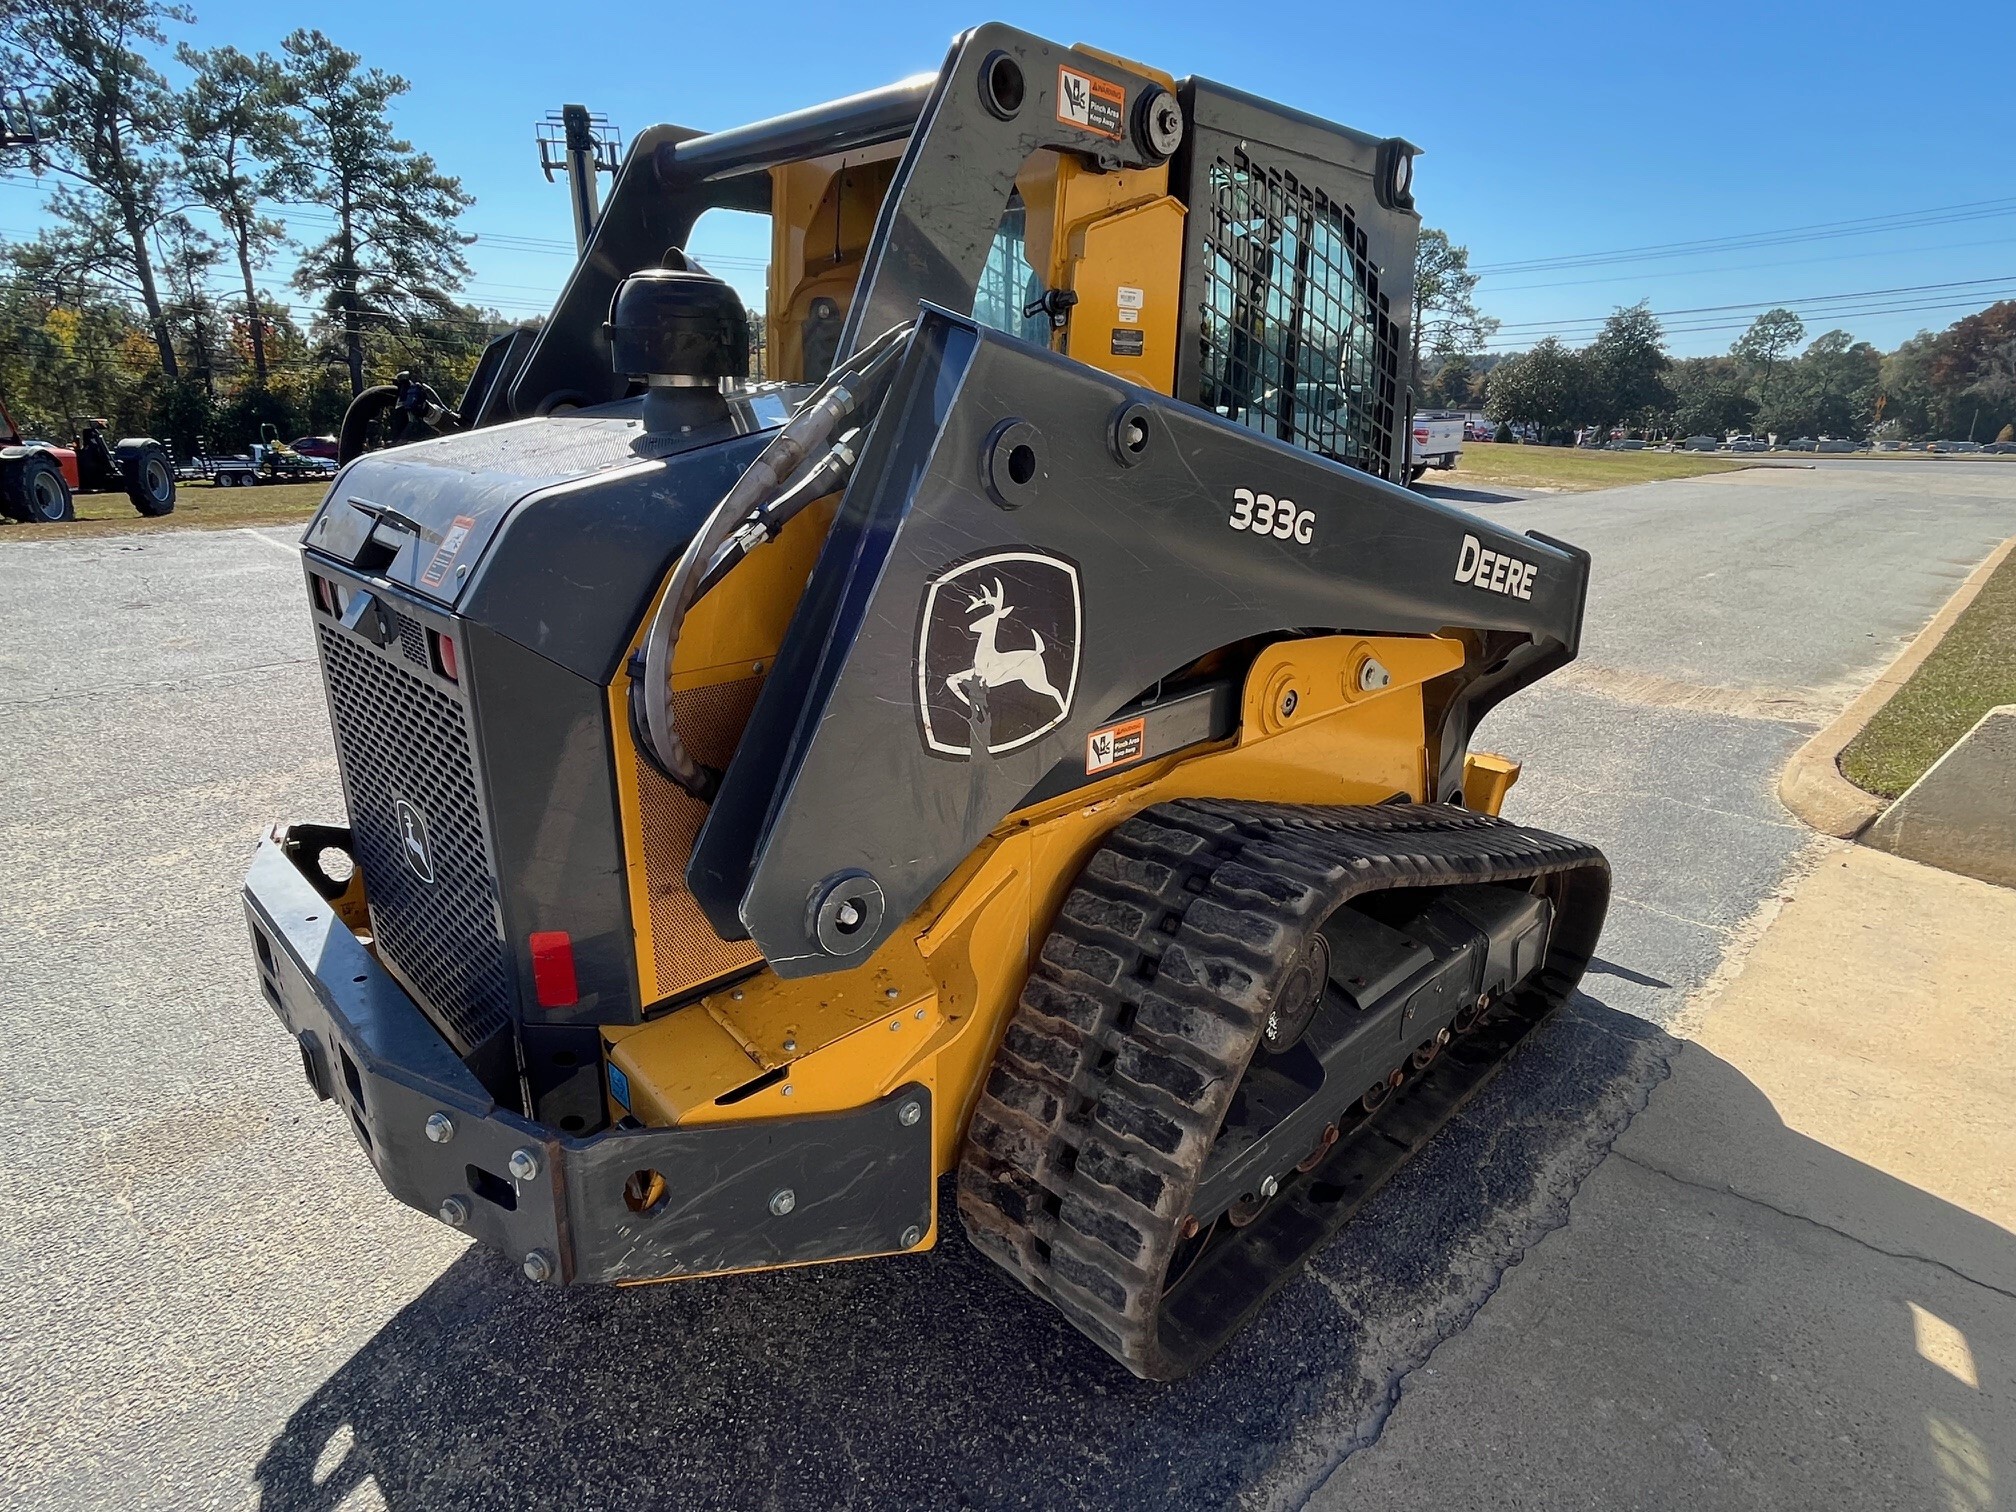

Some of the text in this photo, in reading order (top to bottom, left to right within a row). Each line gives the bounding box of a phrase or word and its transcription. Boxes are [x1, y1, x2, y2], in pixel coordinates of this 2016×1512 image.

[1097, 84, 1122, 99] WARNING
[1091, 101, 1120, 118] Pinch Area
[1090, 114, 1115, 129] Keep Away
[1229, 488, 1316, 544] 333G
[1455, 534, 1537, 600] DEERE
